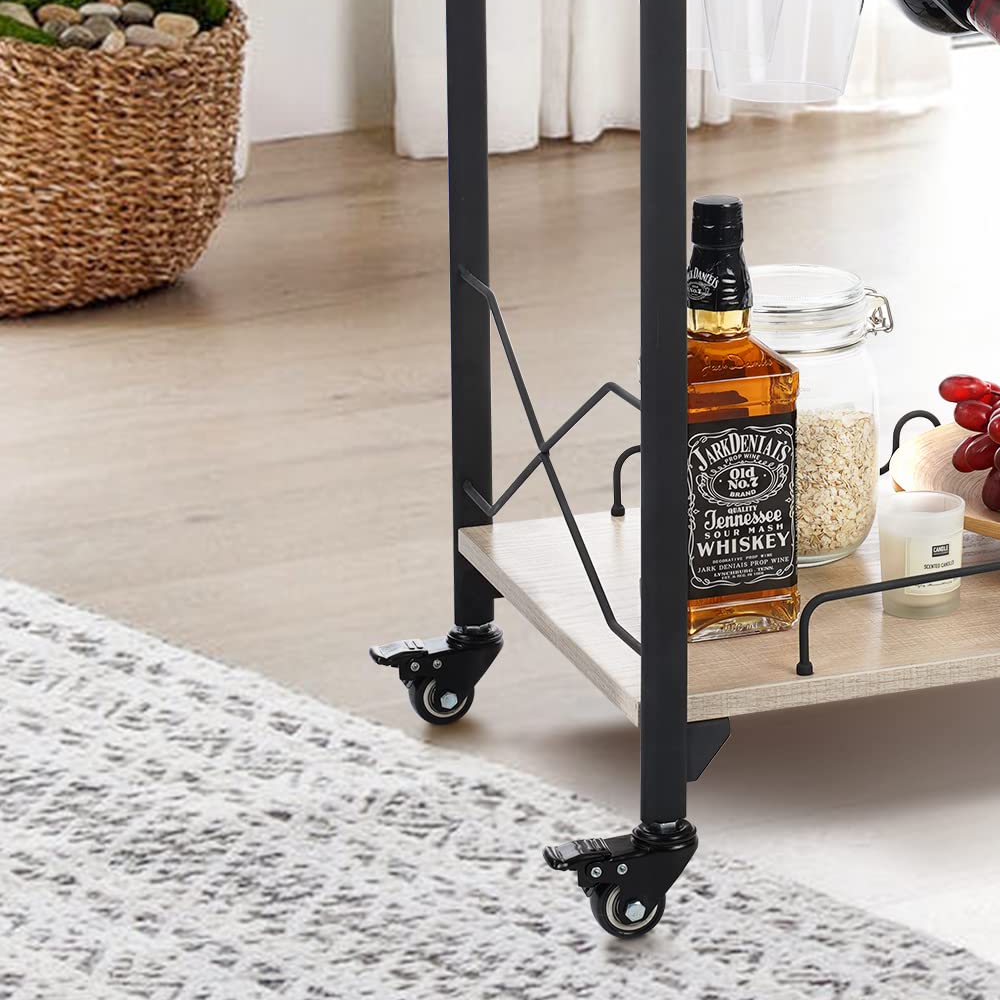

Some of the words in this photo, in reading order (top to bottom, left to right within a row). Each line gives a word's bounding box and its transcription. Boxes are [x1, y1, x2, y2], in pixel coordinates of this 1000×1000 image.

[725, 454, 742, 464] PROP
[729, 467, 755, 480] Old
[728, 476, 759, 490] No.7
[729, 489, 757, 497] BRAND
[728, 505, 758, 514] QUALITY
[704, 509, 782, 531] Tennessee
[704, 529, 740, 540] SOUR
[748, 523, 784, 534] MASH
[696, 531, 790, 558] WHISKEY
[697, 565, 716, 573] JARK
[719, 562, 748, 571] DENIAIS
[750, 559, 768, 567] PROP
[771, 556, 790, 564] WINE
